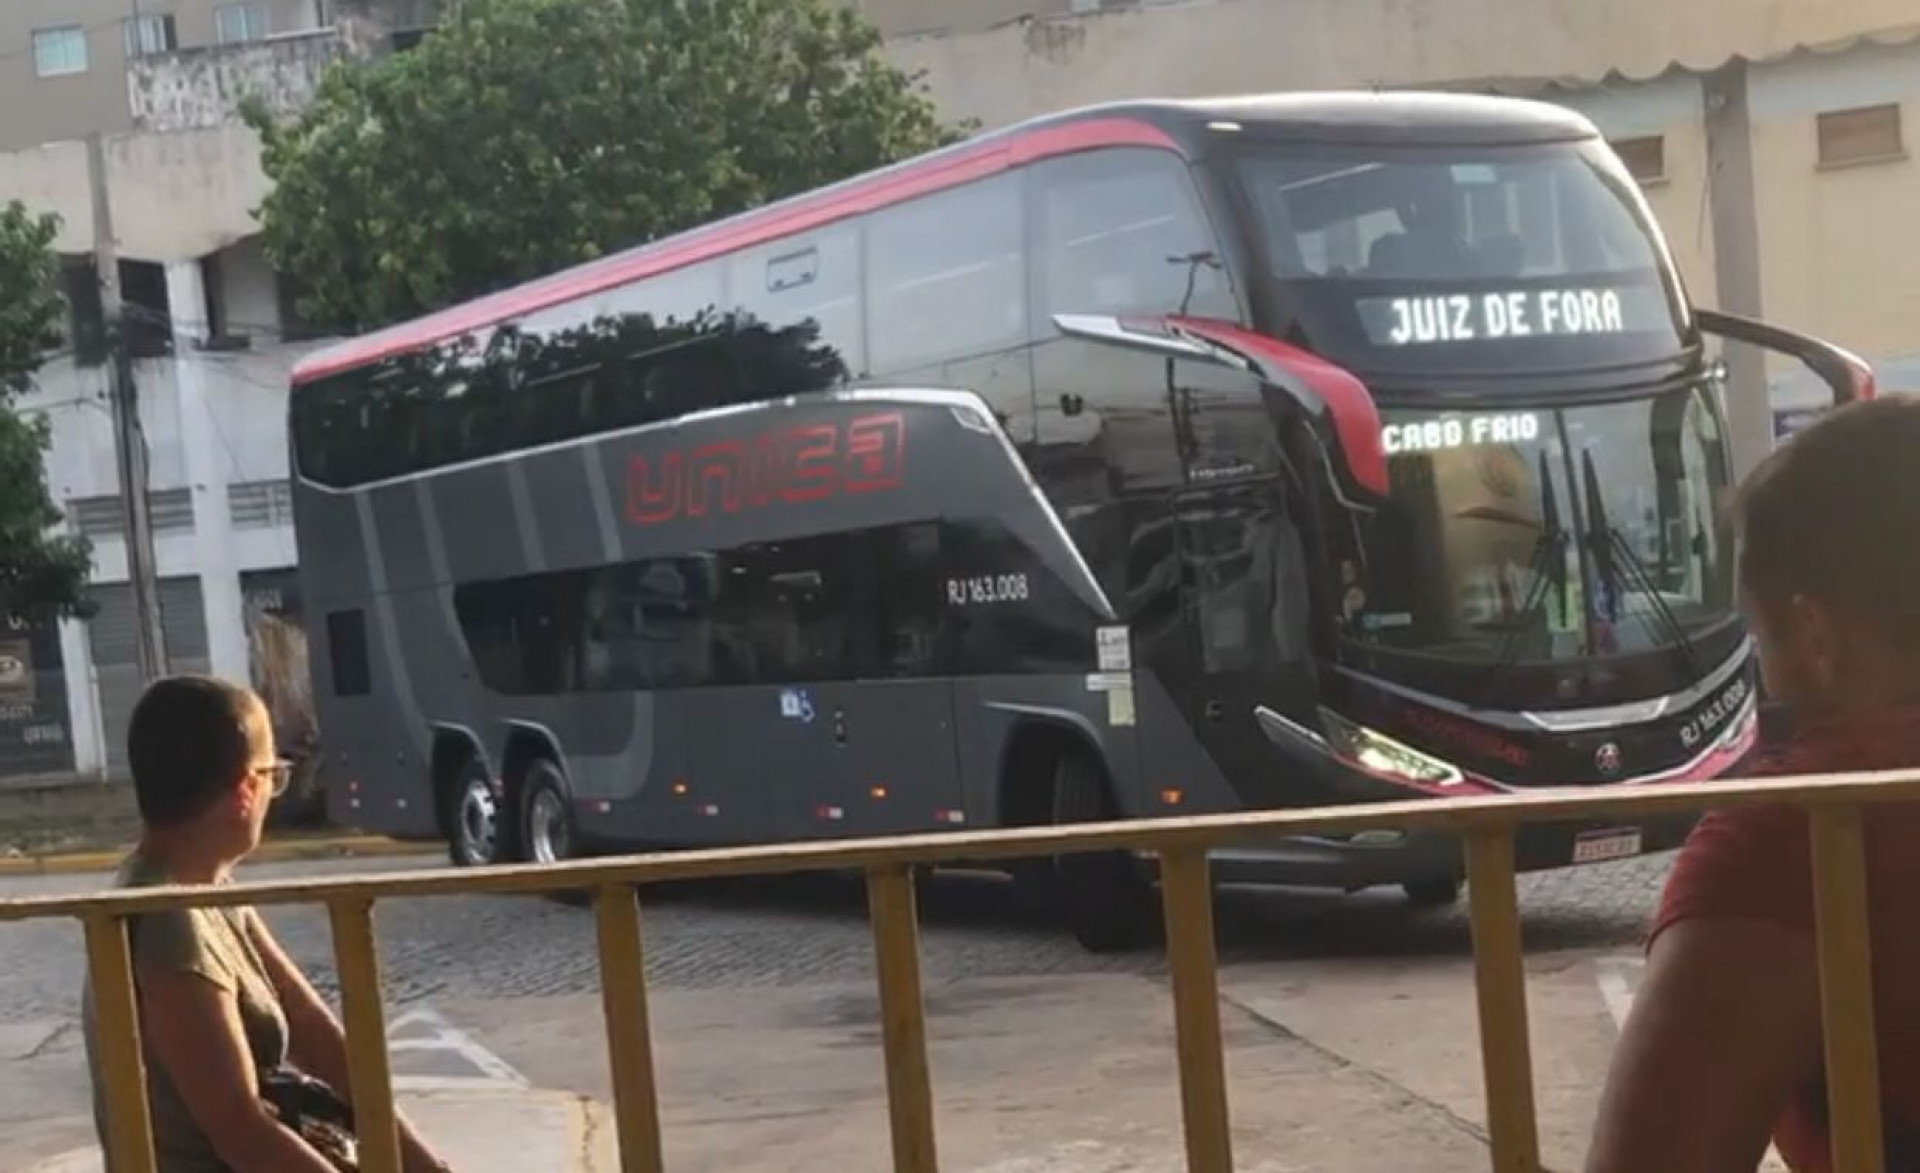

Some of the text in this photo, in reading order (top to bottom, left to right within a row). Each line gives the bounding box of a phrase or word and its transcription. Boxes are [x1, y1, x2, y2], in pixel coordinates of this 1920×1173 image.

[1390, 289, 1623, 344] JUIZ DE FORA
[1381, 412, 1539, 453] CABO FRIO
[947, 578, 967, 605] RJ
